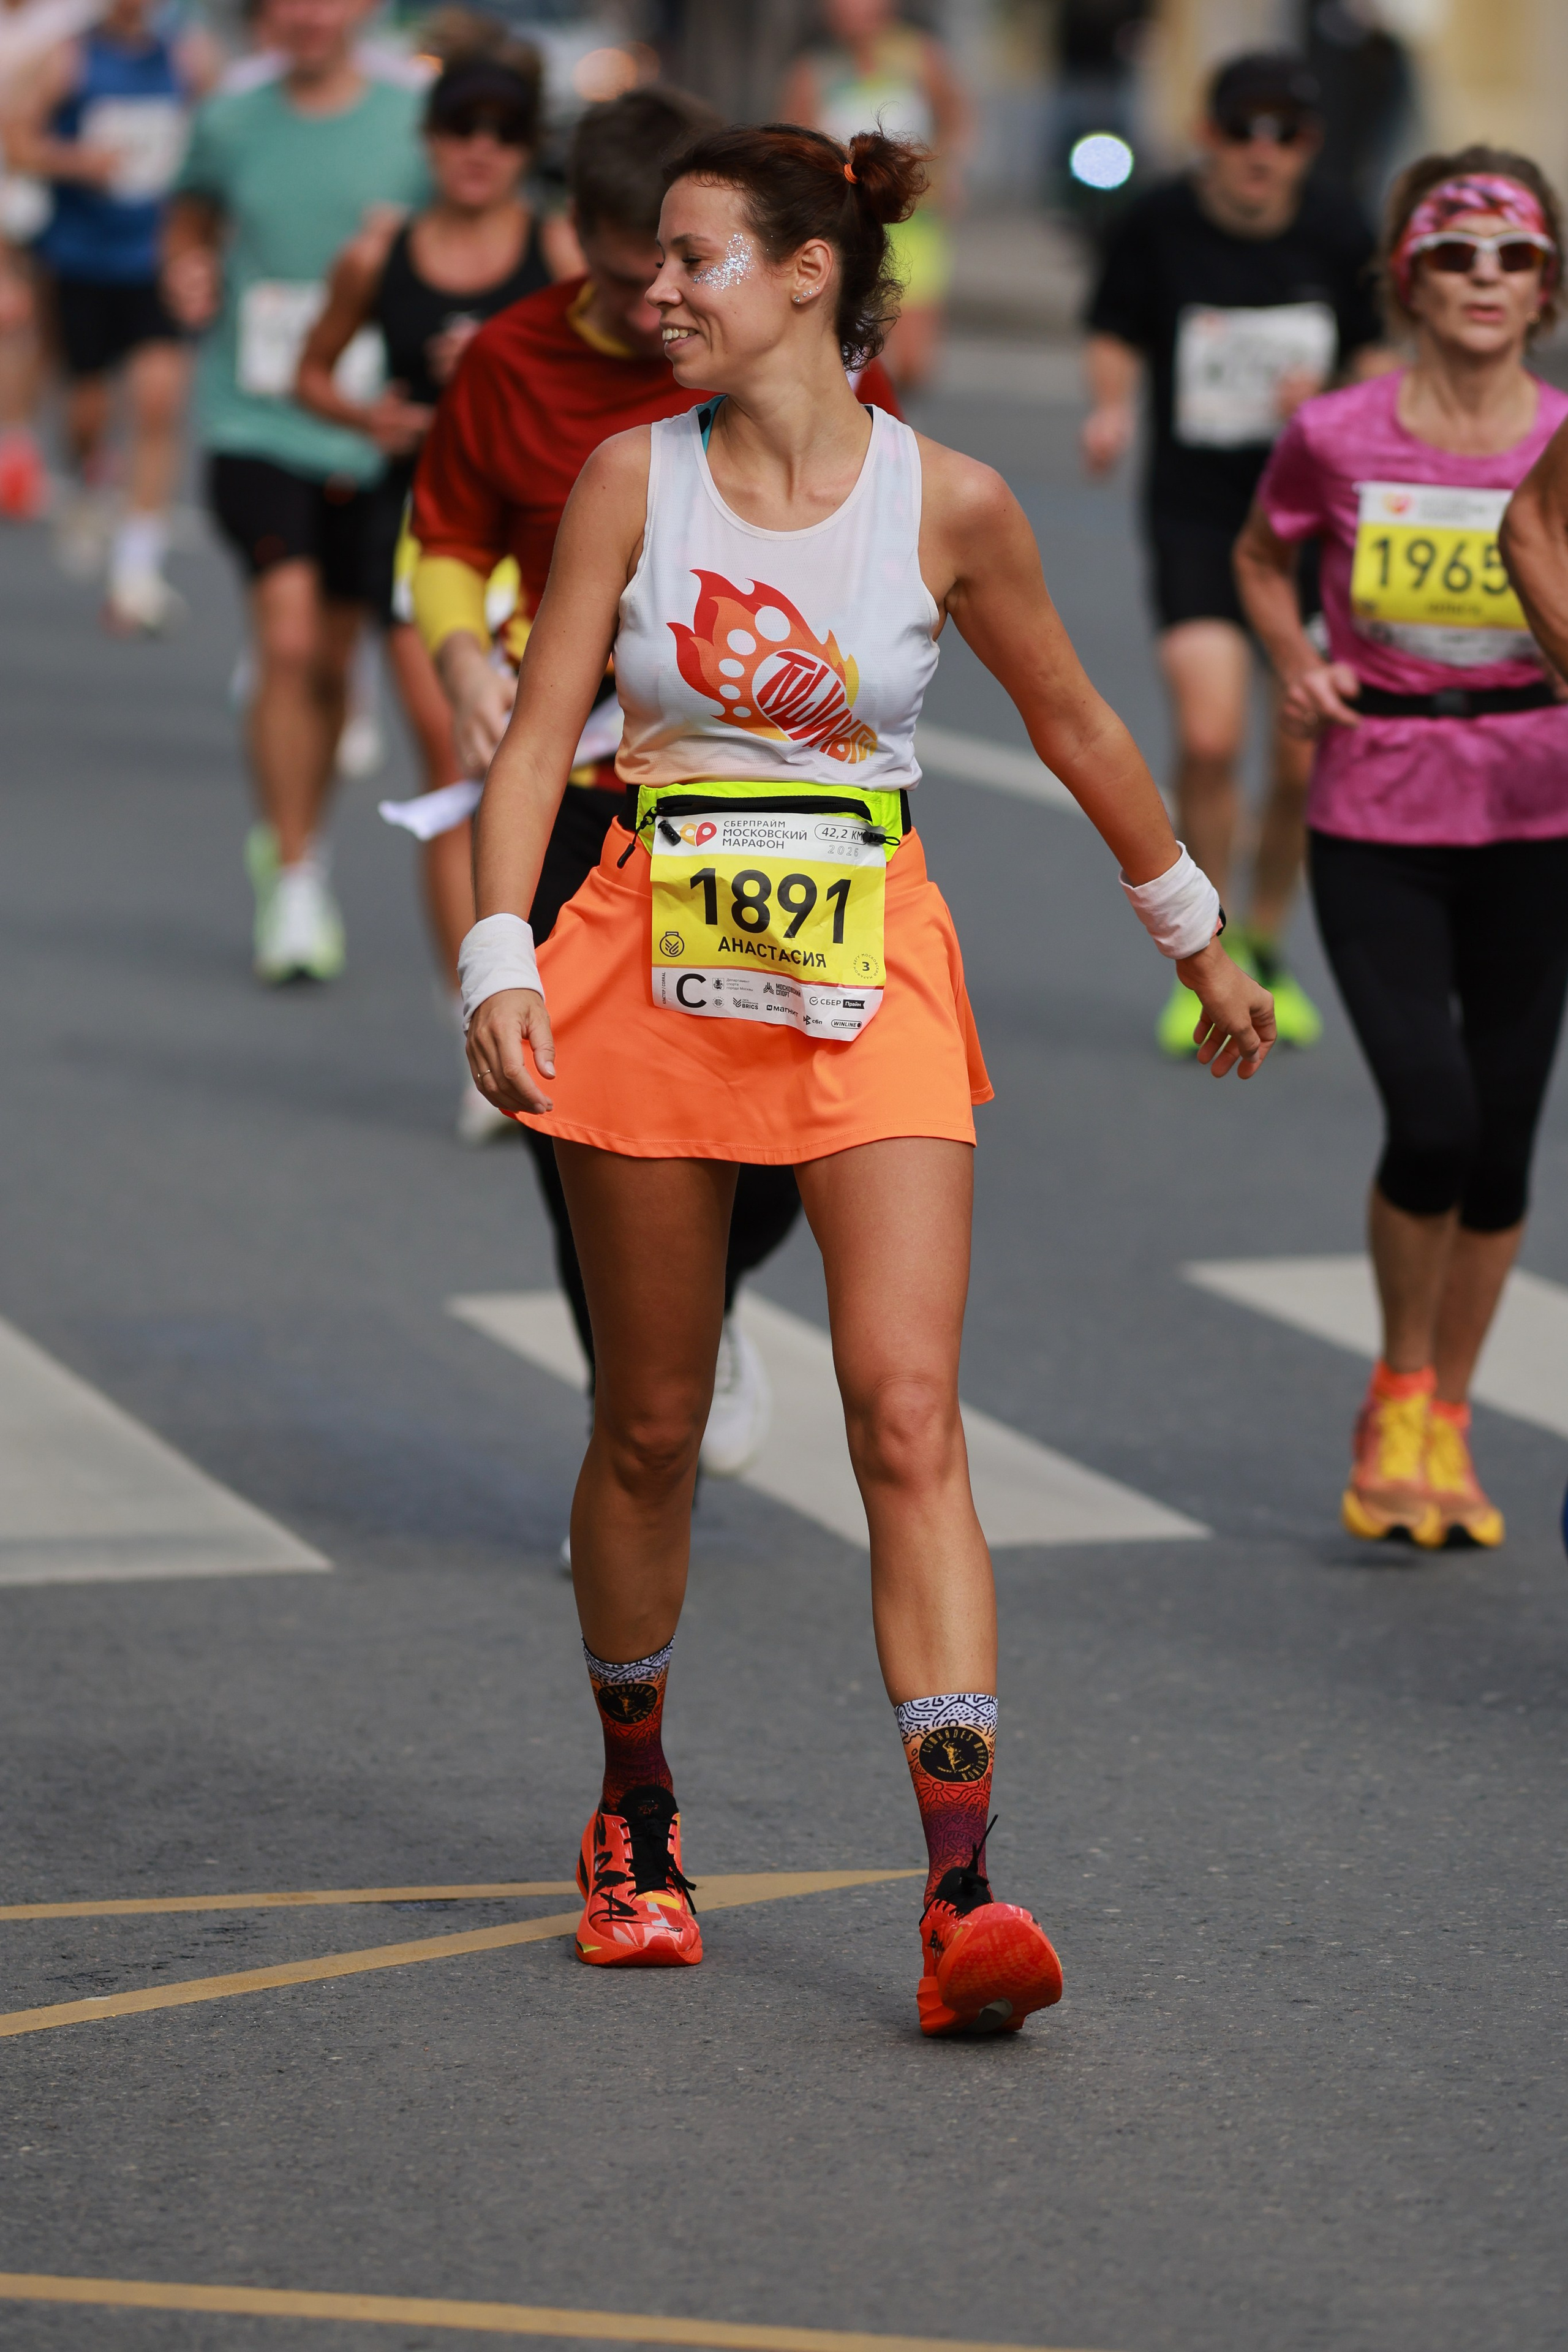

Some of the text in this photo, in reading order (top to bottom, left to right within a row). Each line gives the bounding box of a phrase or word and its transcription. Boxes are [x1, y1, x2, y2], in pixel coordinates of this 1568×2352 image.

[1370, 535, 1509, 595] 1965
[723, 829, 807, 840] МОСКОВСКИЙ
[822, 827, 848, 839] 42,2
[722, 838, 785, 849] МАРАФОН
[690, 867, 851, 944] 1891
[718, 936, 826, 968] АНАСТАСИЯ
[862, 962, 870, 971] 3
[676, 973, 707, 1008] C
[775, 983, 801, 998] МОСКОВСКИЙ
[773, 1005, 799, 1017] магнит
[922, 1728, 974, 1754] COMRADES
